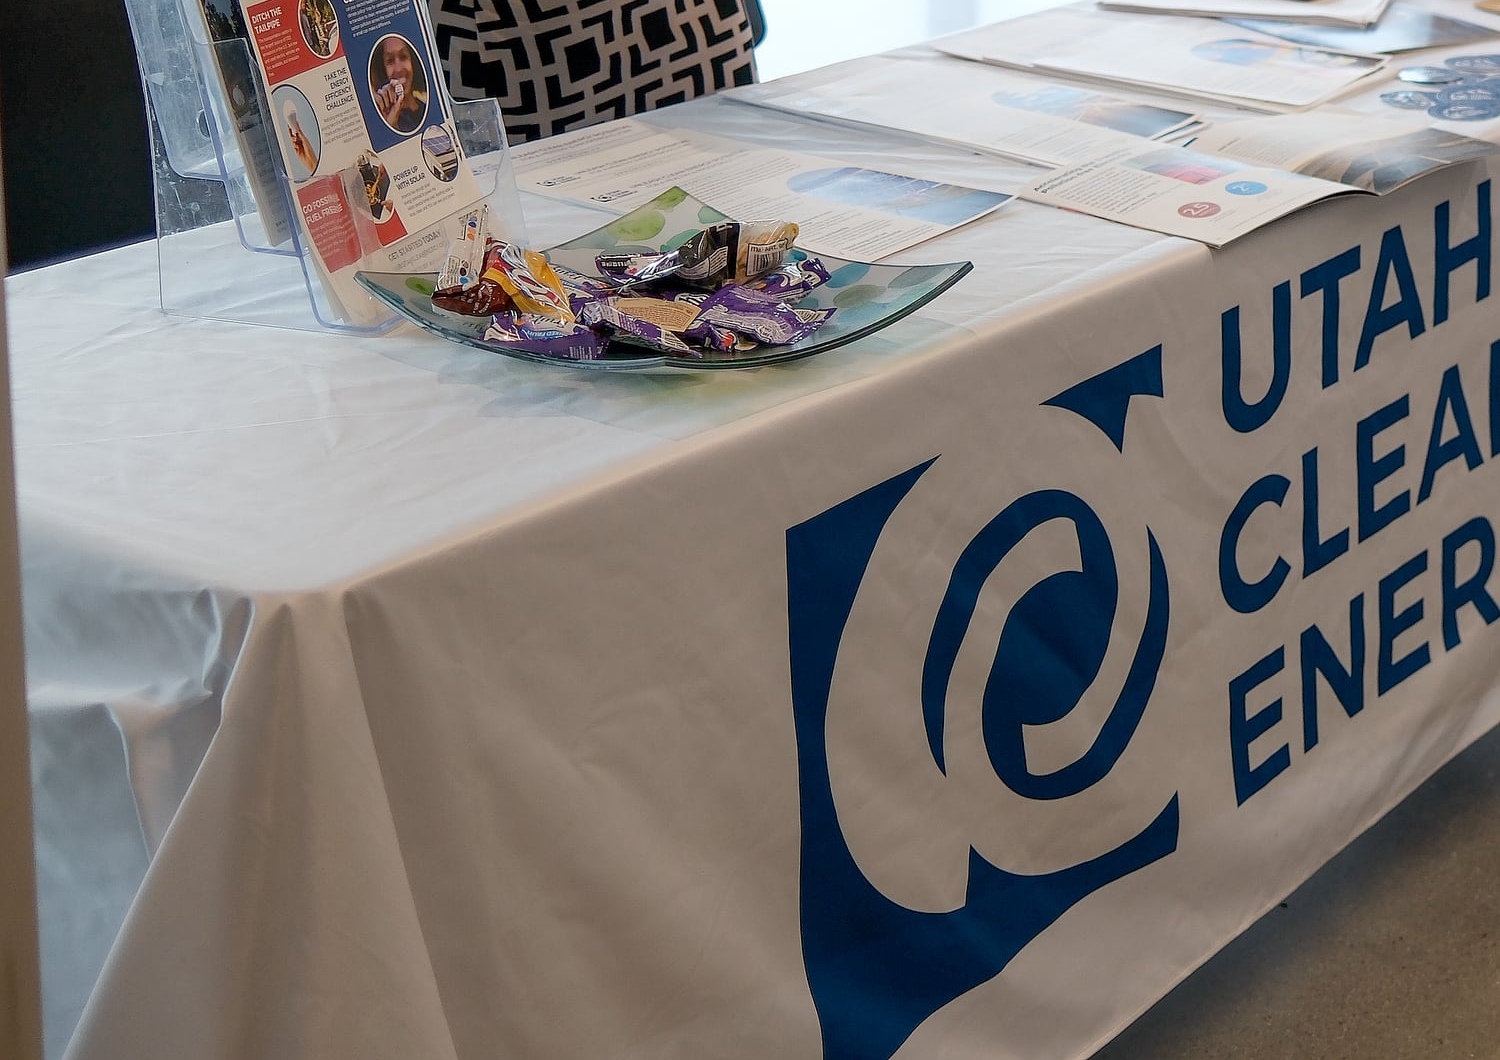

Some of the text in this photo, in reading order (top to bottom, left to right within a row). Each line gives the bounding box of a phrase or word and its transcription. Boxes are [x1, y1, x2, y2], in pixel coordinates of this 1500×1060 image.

[251, 6, 283, 24] DITCH THE
[254, 20, 281, 35] TAILPIPE
[324, 67, 348, 83] TAKE THE
[329, 76, 350, 90] ENERGY
[325, 86, 353, 102] EFFICIENCY
[326, 94, 355, 112] CHALLENGE
[393, 165, 419, 183] POWER UP
[395, 172, 427, 191] WITH SOLAR
[302, 201, 316, 215] GO
[1183, 203, 1210, 216] 25
[305, 209, 327, 226] FUEL
[388, 249, 400, 262] GET
[399, 238, 426, 257] STARTED
[425, 228, 442, 243] TODAY
[1221, 179, 1492, 434] UTAH
